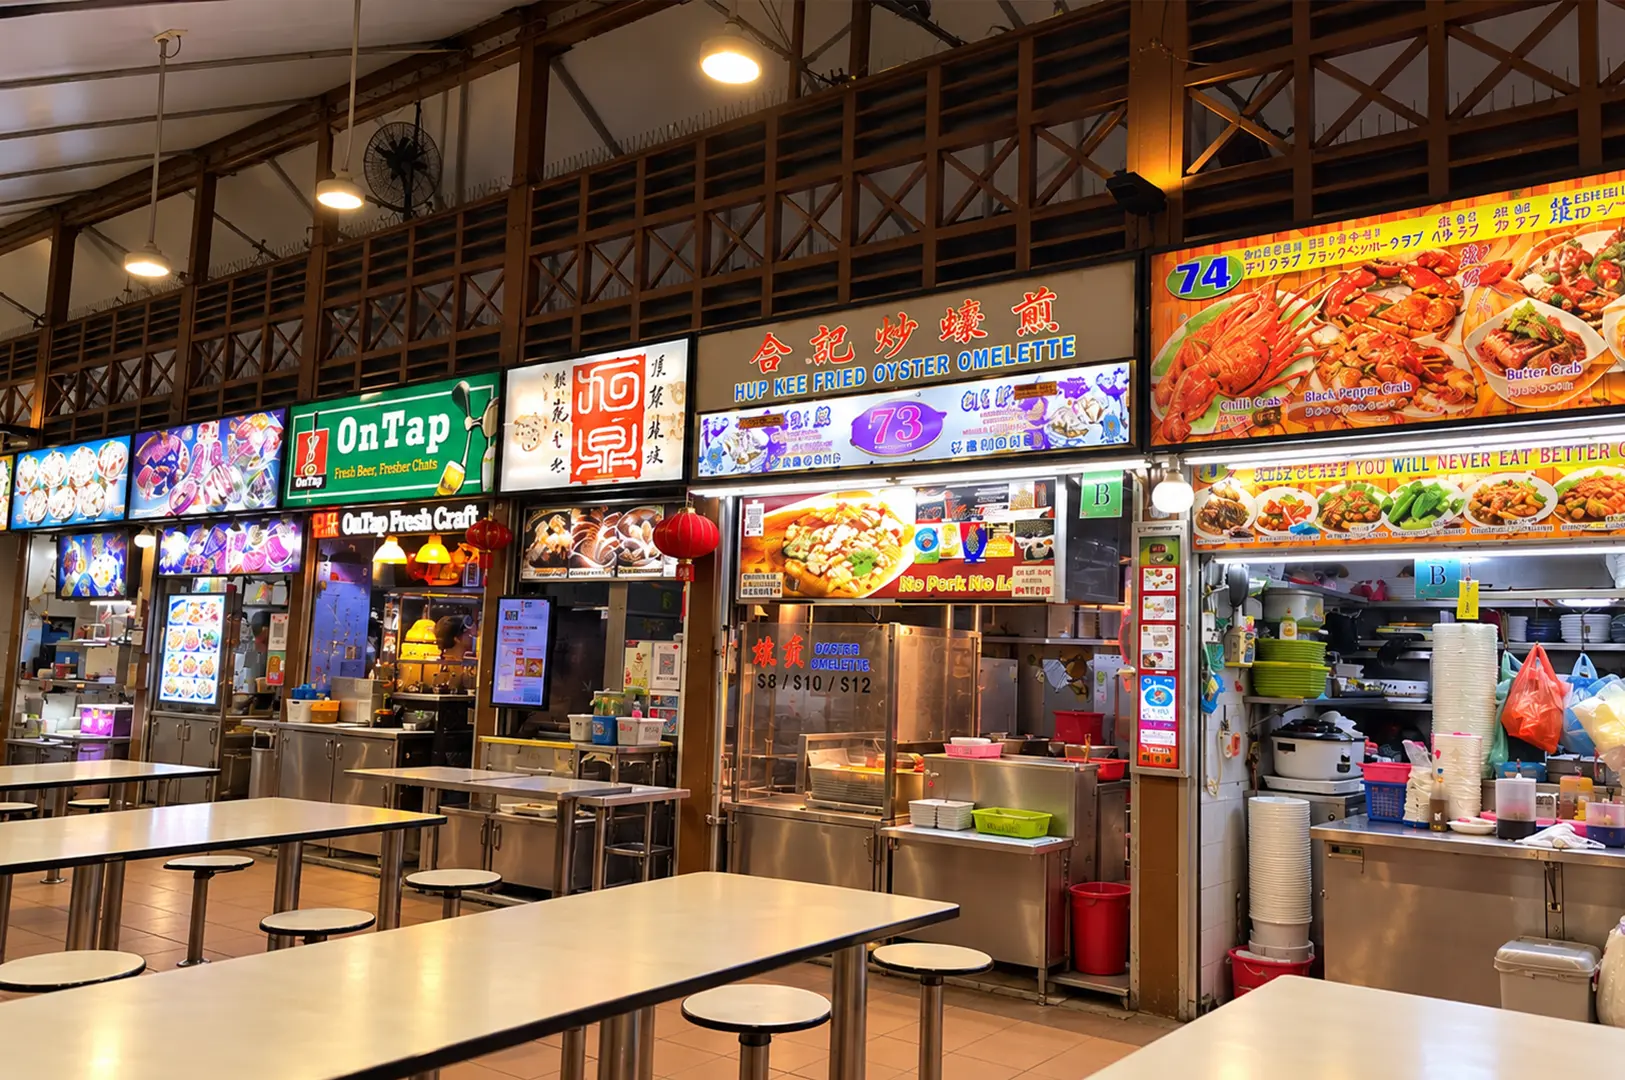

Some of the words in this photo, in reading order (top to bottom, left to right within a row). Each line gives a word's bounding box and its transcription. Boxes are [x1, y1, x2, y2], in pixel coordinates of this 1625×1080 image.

[1176, 256, 1232, 295] 74
[734, 380, 768, 402] HUP
[774, 374, 807, 397] KEE
[813, 367, 867, 392] FRIED
[873, 354, 950, 383] OYSTER
[957, 335, 1076, 371] OMELETTE
[1506, 366, 1547, 381] Butter
[1551, 360, 1583, 376] Crab
[1304, 389, 1336, 403] Black
[1338, 386, 1379, 402] Pepper
[1382, 381, 1412, 395] Crab
[1220, 397, 1251, 412] Chilli
[1254, 395, 1283, 409] Crab
[868, 405, 924, 444] 73
[334, 465, 356, 480] Fresh
[379, 460, 411, 475] Fresher
[412, 458, 438, 472] Chats
[1356, 459, 1386, 475] YOU
[1437, 452, 1492, 470] NEVER
[1499, 449, 1533, 466] EAT
[1540, 443, 1612, 464] BETTER
[1094, 483, 1111, 505] B
[389, 507, 433, 532] Fresh
[433, 504, 479, 531] Craft
[898, 575, 925, 592] No
[926, 574, 967, 592] Pork
[968, 574, 995, 592] No
[1430, 565, 1446, 585] B
